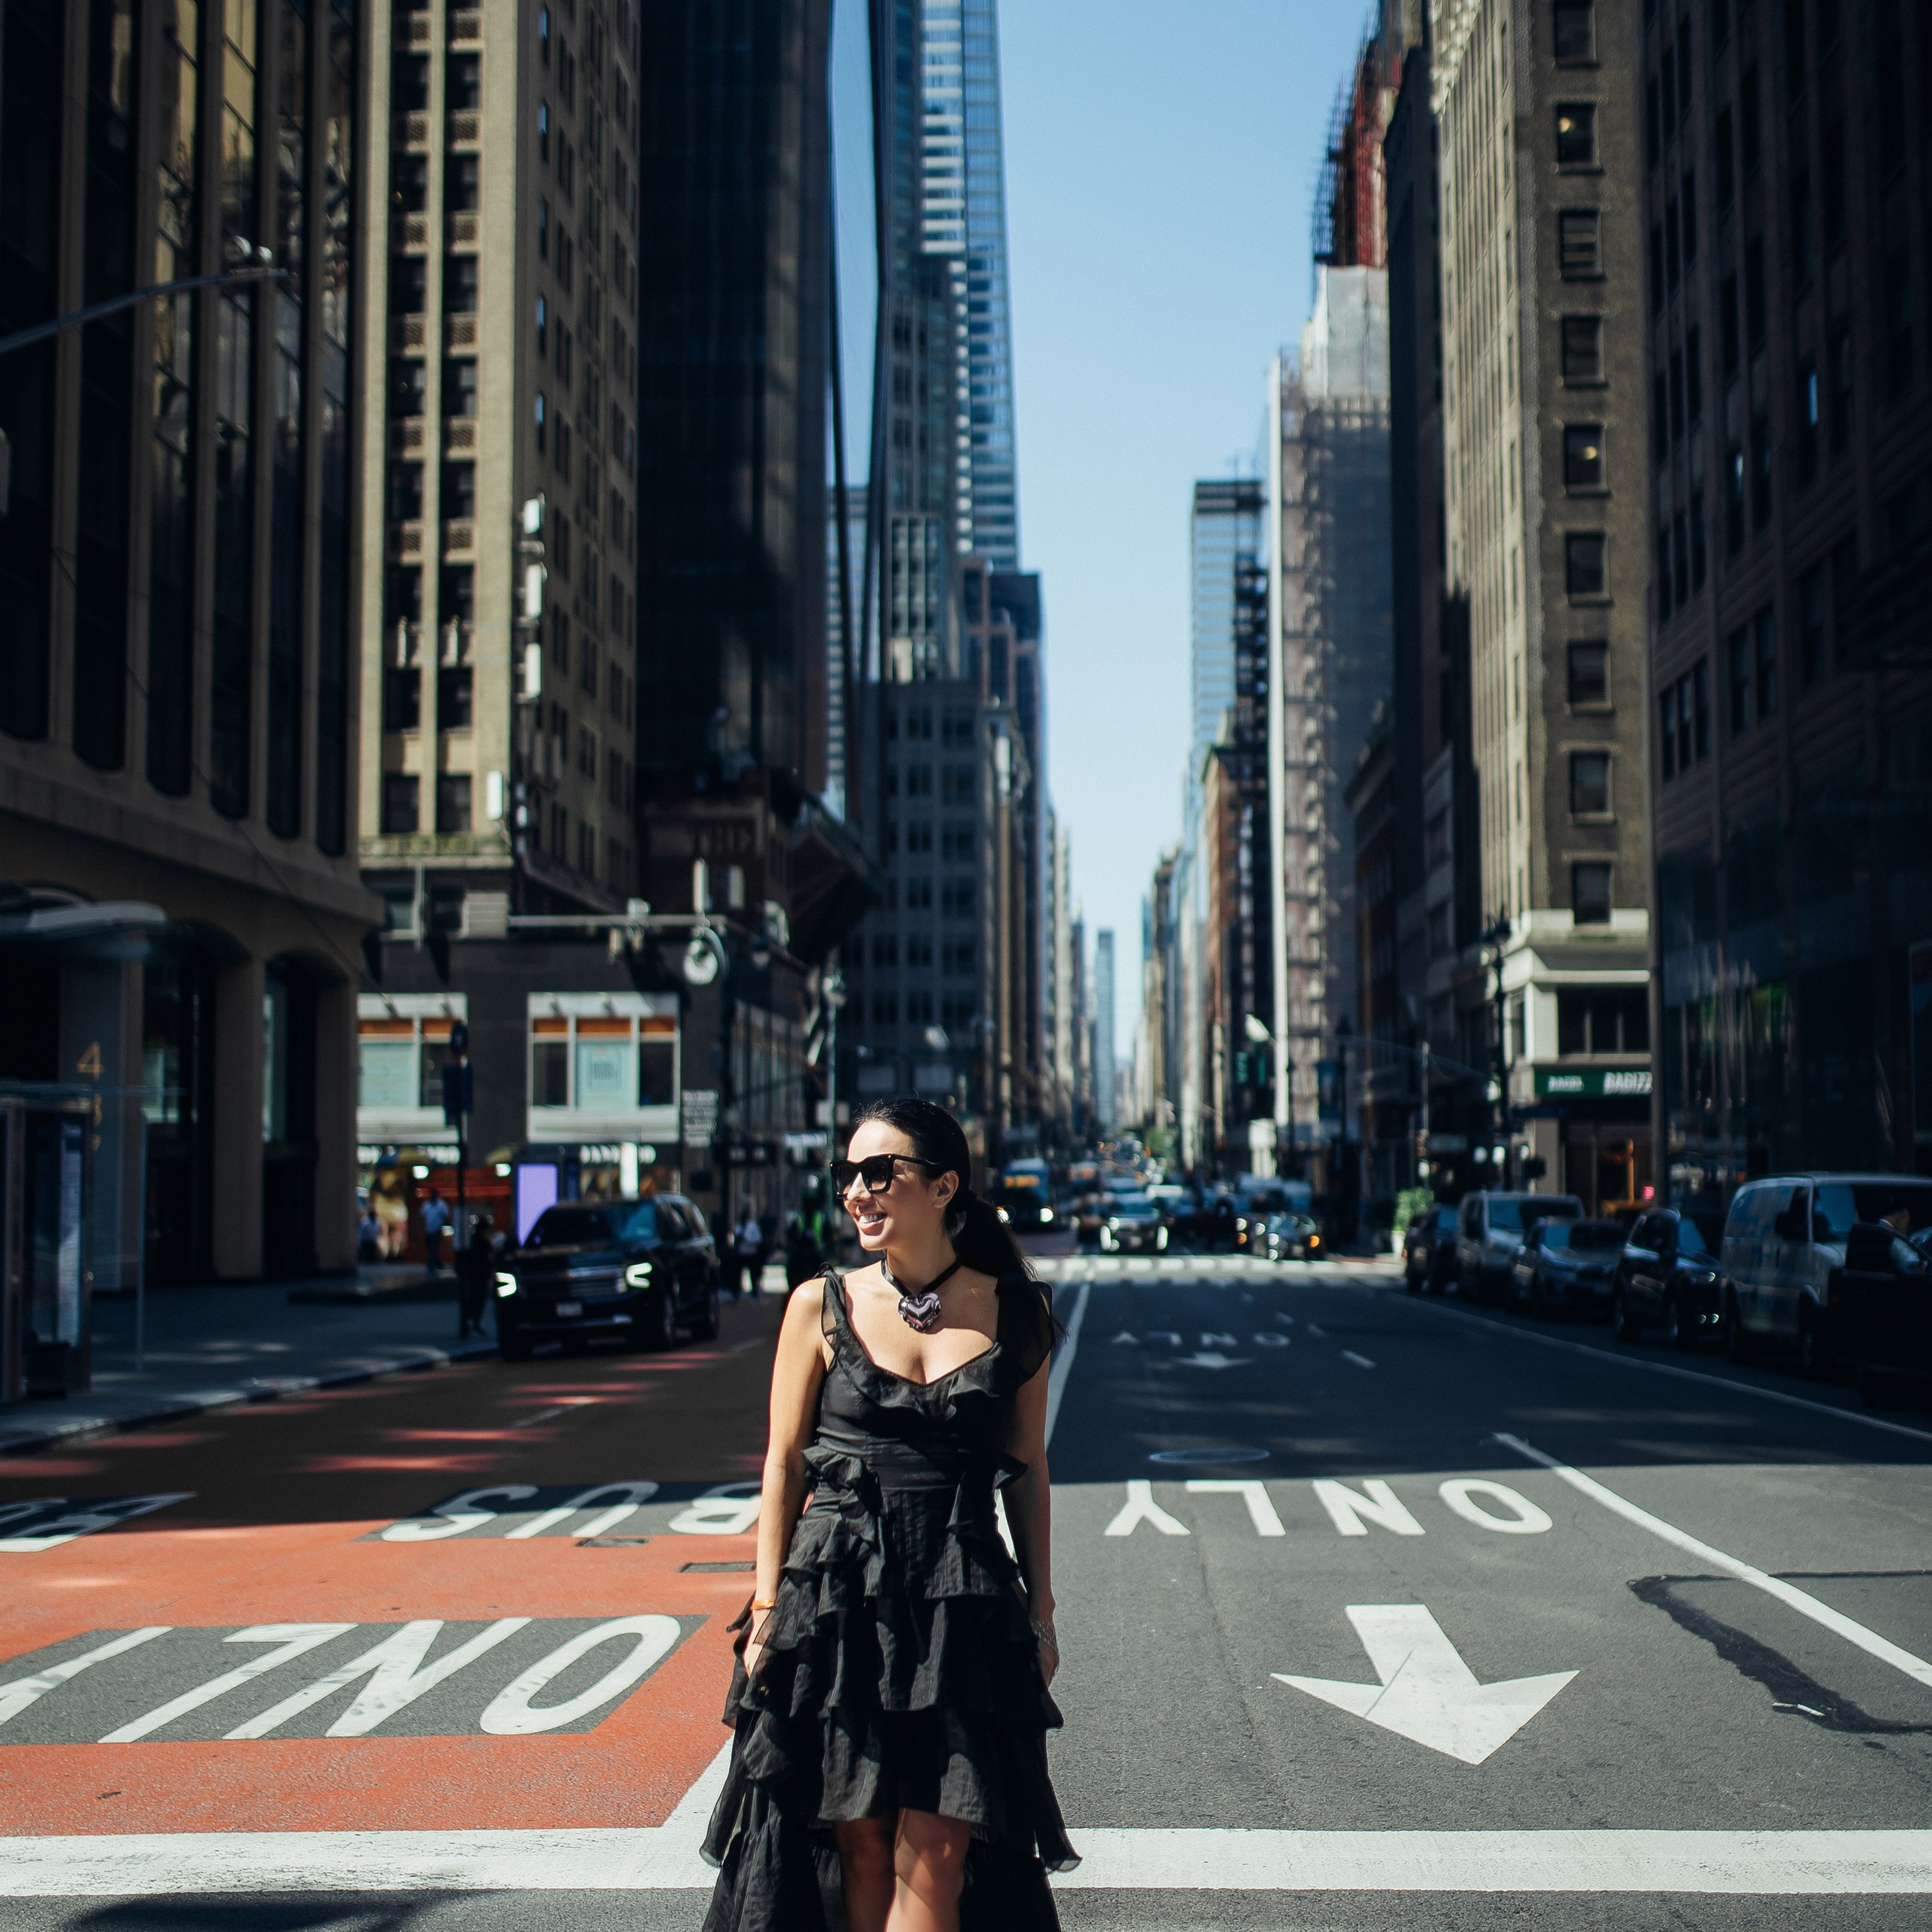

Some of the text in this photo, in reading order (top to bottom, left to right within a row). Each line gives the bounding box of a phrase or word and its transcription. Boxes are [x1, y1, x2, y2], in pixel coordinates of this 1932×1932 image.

[1111, 1330, 1291, 1347] ONLY
[381, 1480, 763, 1542] BUS
[1104, 1478, 1553, 1537] ONLY
